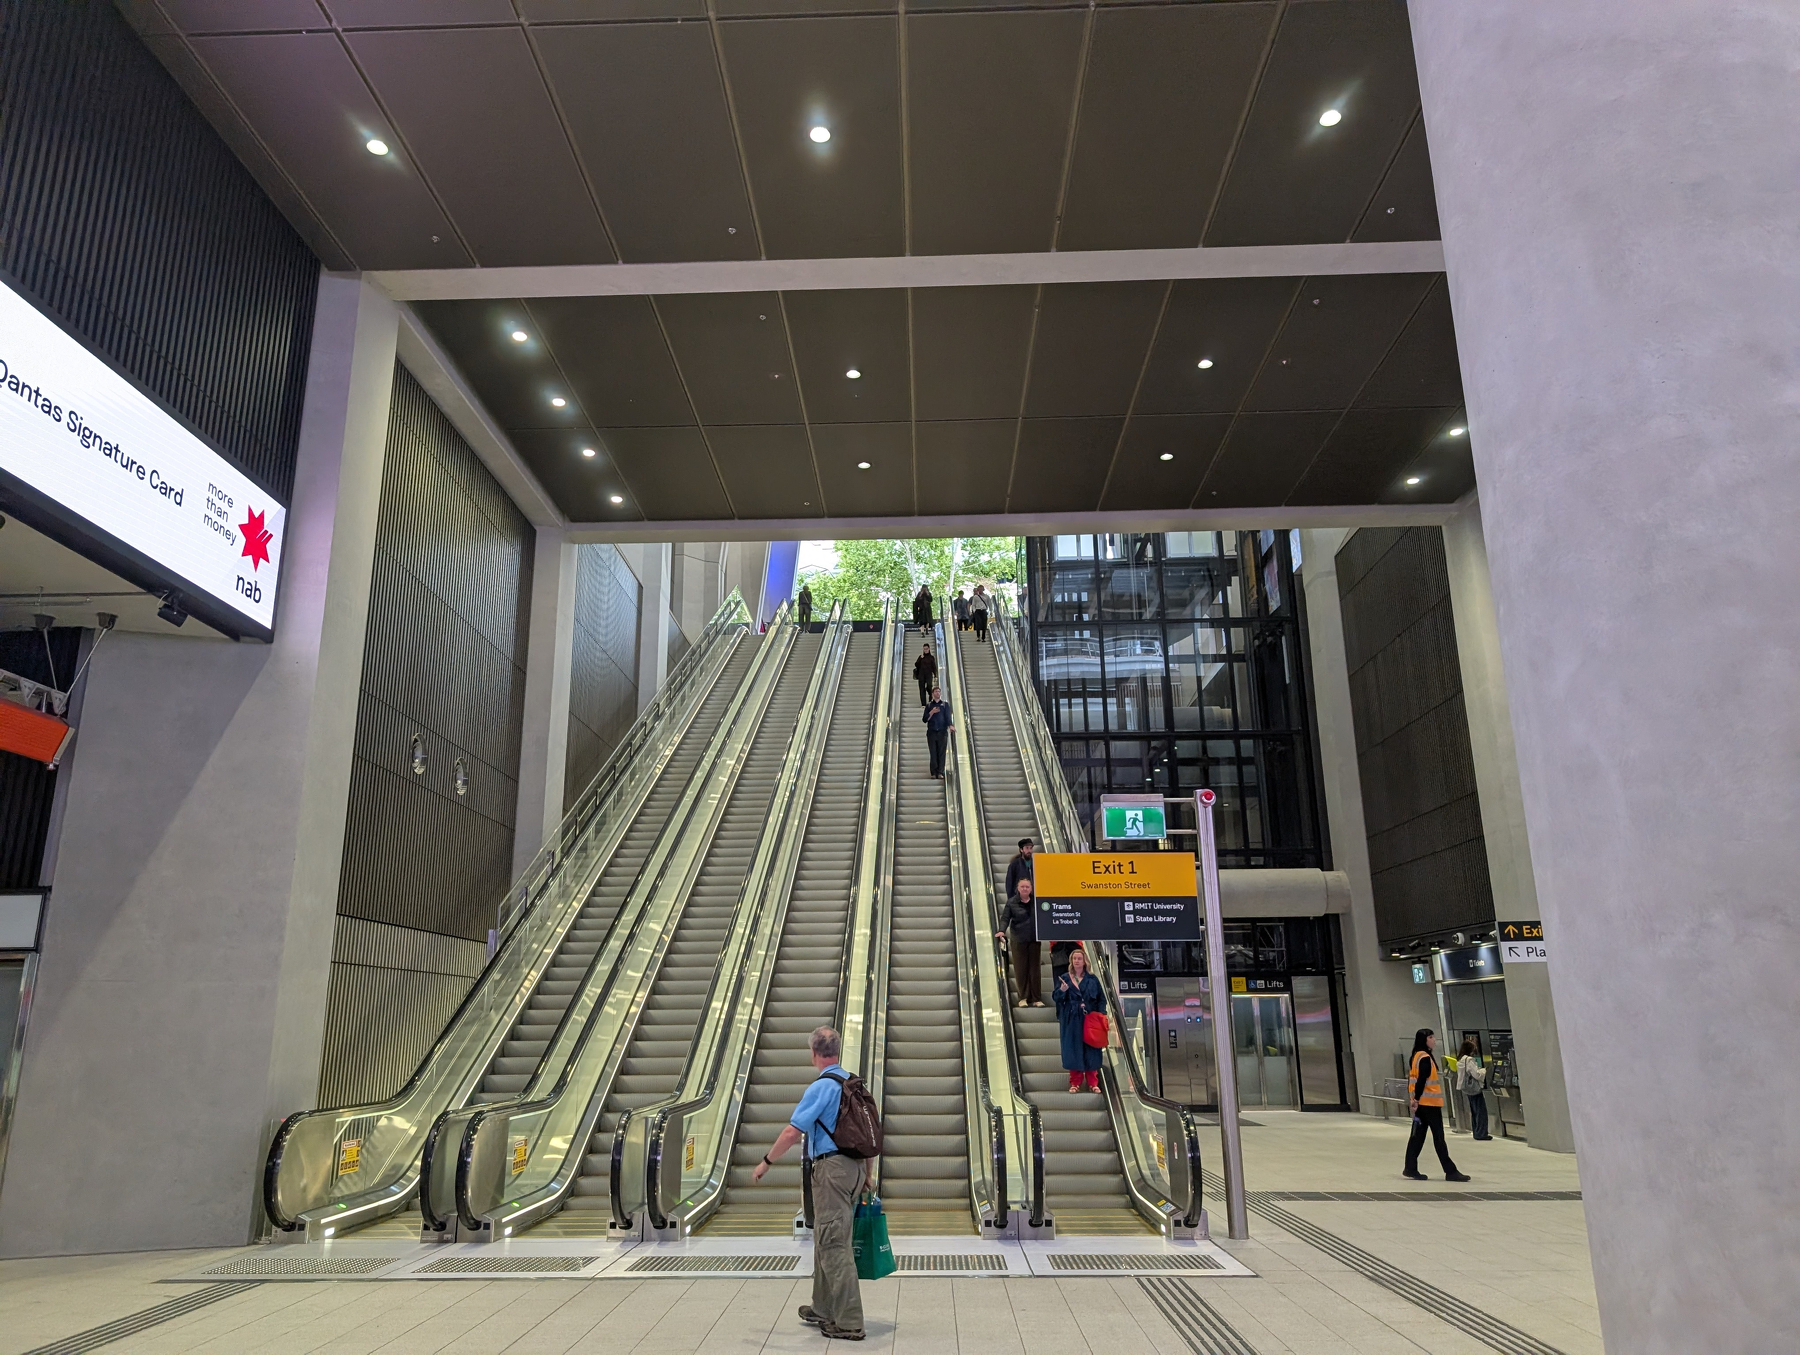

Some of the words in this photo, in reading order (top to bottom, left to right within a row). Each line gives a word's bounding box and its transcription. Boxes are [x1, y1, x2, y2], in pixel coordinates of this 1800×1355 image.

[66, 410, 146, 480] Signature
[149, 469, 185, 507] Card
[207, 482, 234, 508] more
[206, 496, 228, 522] than
[203, 513, 237, 546] money
[235, 574, 262, 604] nab
[1092, 860, 1124, 875] Exit
[1128, 860, 1138, 875] 1
[1080, 881, 1122, 889] Swanston
[1124, 881, 1151, 889] Street
[1134, 902, 1152, 910] RMIT
[1153, 902, 1185, 911] University
[1154, 915, 1177, 923] Library
[1266, 980, 1284, 988] Lifts
